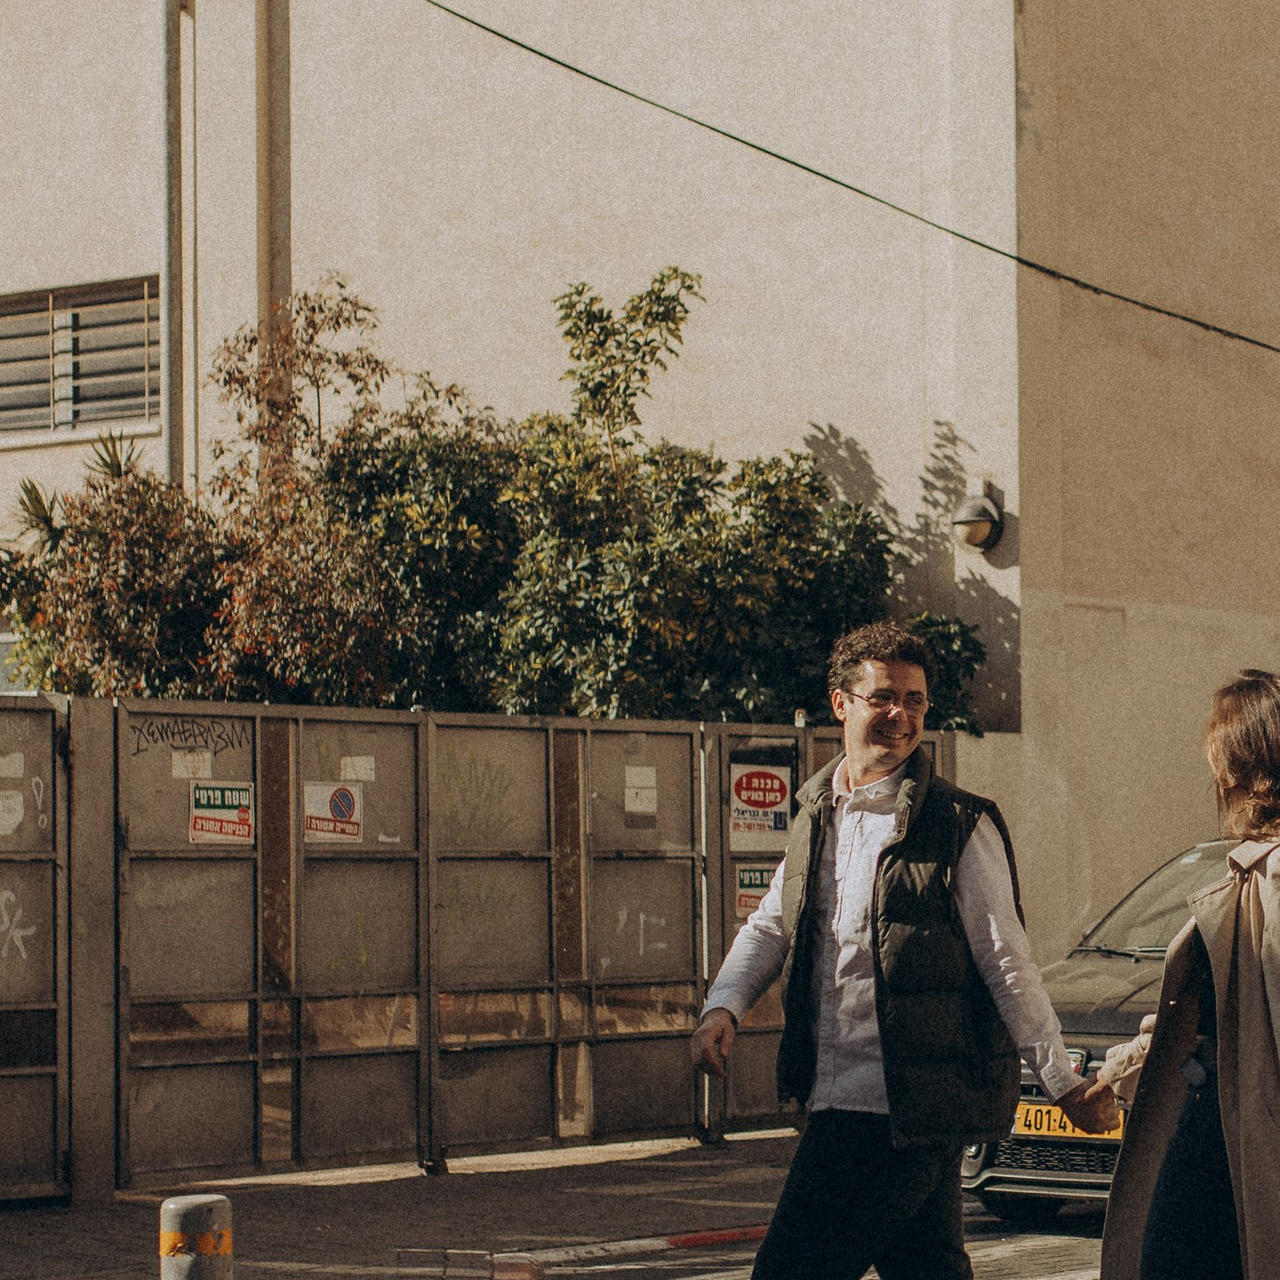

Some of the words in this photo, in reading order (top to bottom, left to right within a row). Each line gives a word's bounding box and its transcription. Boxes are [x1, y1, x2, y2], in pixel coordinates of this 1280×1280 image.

[752, 777, 780, 790] סכנה
[195, 788, 222, 806] פרטי
[224, 789, 250, 806] שטח
[740, 790, 765, 802] בונים
[765, 791, 782, 804] כאן
[195, 818, 222, 833] אסורה
[222, 821, 250, 837] הכניסה
[740, 871, 761, 885] פרטי
